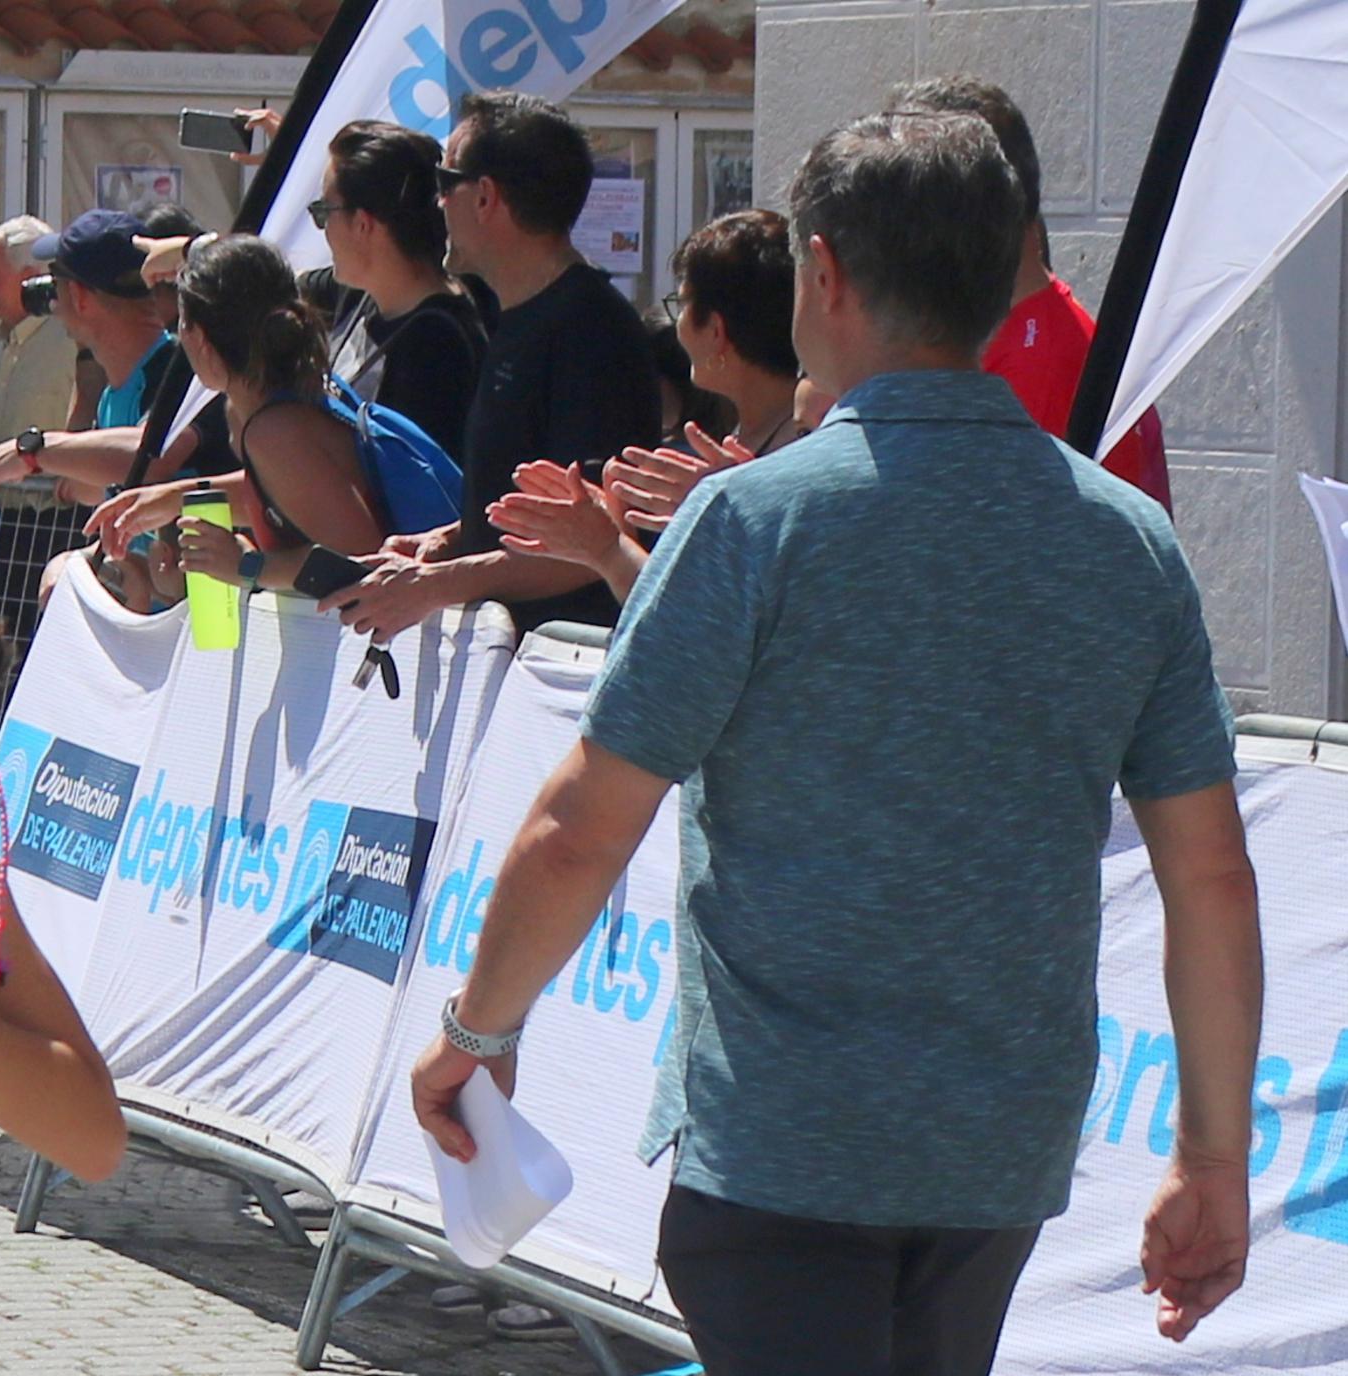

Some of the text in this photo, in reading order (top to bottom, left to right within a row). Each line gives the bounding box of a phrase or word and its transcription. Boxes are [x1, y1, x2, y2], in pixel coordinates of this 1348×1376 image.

[35, 761, 120, 821] Diputación
[21, 812, 113, 874] DE PALENCIA
[336, 834, 411, 887] Diputación
[339, 898, 409, 955] PALENCIA
